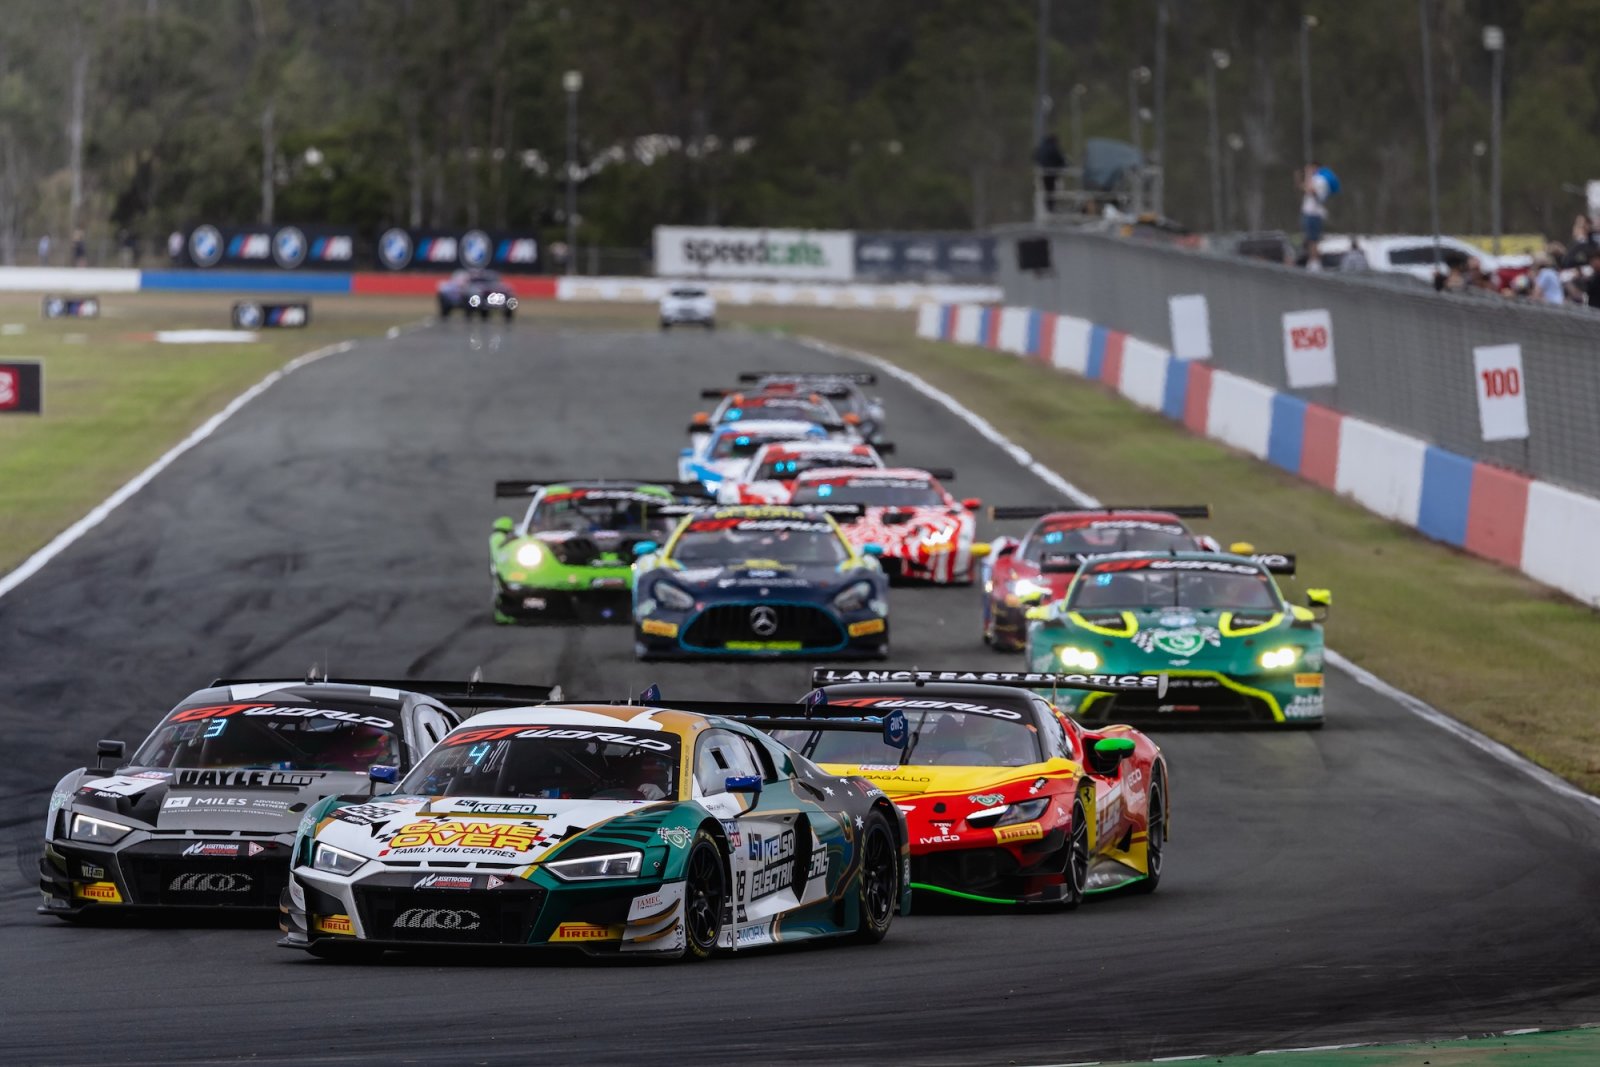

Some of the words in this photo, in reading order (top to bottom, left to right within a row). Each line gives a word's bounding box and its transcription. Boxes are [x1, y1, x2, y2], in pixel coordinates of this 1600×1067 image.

[1290, 325, 1328, 351] 150
[1481, 367, 1520, 398] 100
[938, 672, 1019, 682] EAST
[1024, 673, 1158, 686] EXOTICS
[169, 703, 276, 723] GT
[244, 706, 395, 729] WORLD
[873, 699, 1023, 721] WORLD
[203, 718, 229, 738] 3
[890, 716, 904, 731] aws
[440, 726, 552, 746] GT
[515, 729, 672, 751] WORLD
[469, 744, 491, 766] 4
[194, 798, 248, 806] MILES
[472, 803, 537, 813] KELSO
[399, 820, 545, 839] GAME
[389, 832, 535, 853] OVER
[919, 834, 961, 845] IVECO
[393, 847, 438, 856] FAMILY
[461, 847, 517, 859] CENTRES
[764, 832, 795, 866] KELSO
[83, 885, 115, 898] PIRELLI
[636, 896, 662, 911] JAMEC
[321, 916, 351, 932] PIRELLI
[559, 926, 609, 938] PIRELLI
